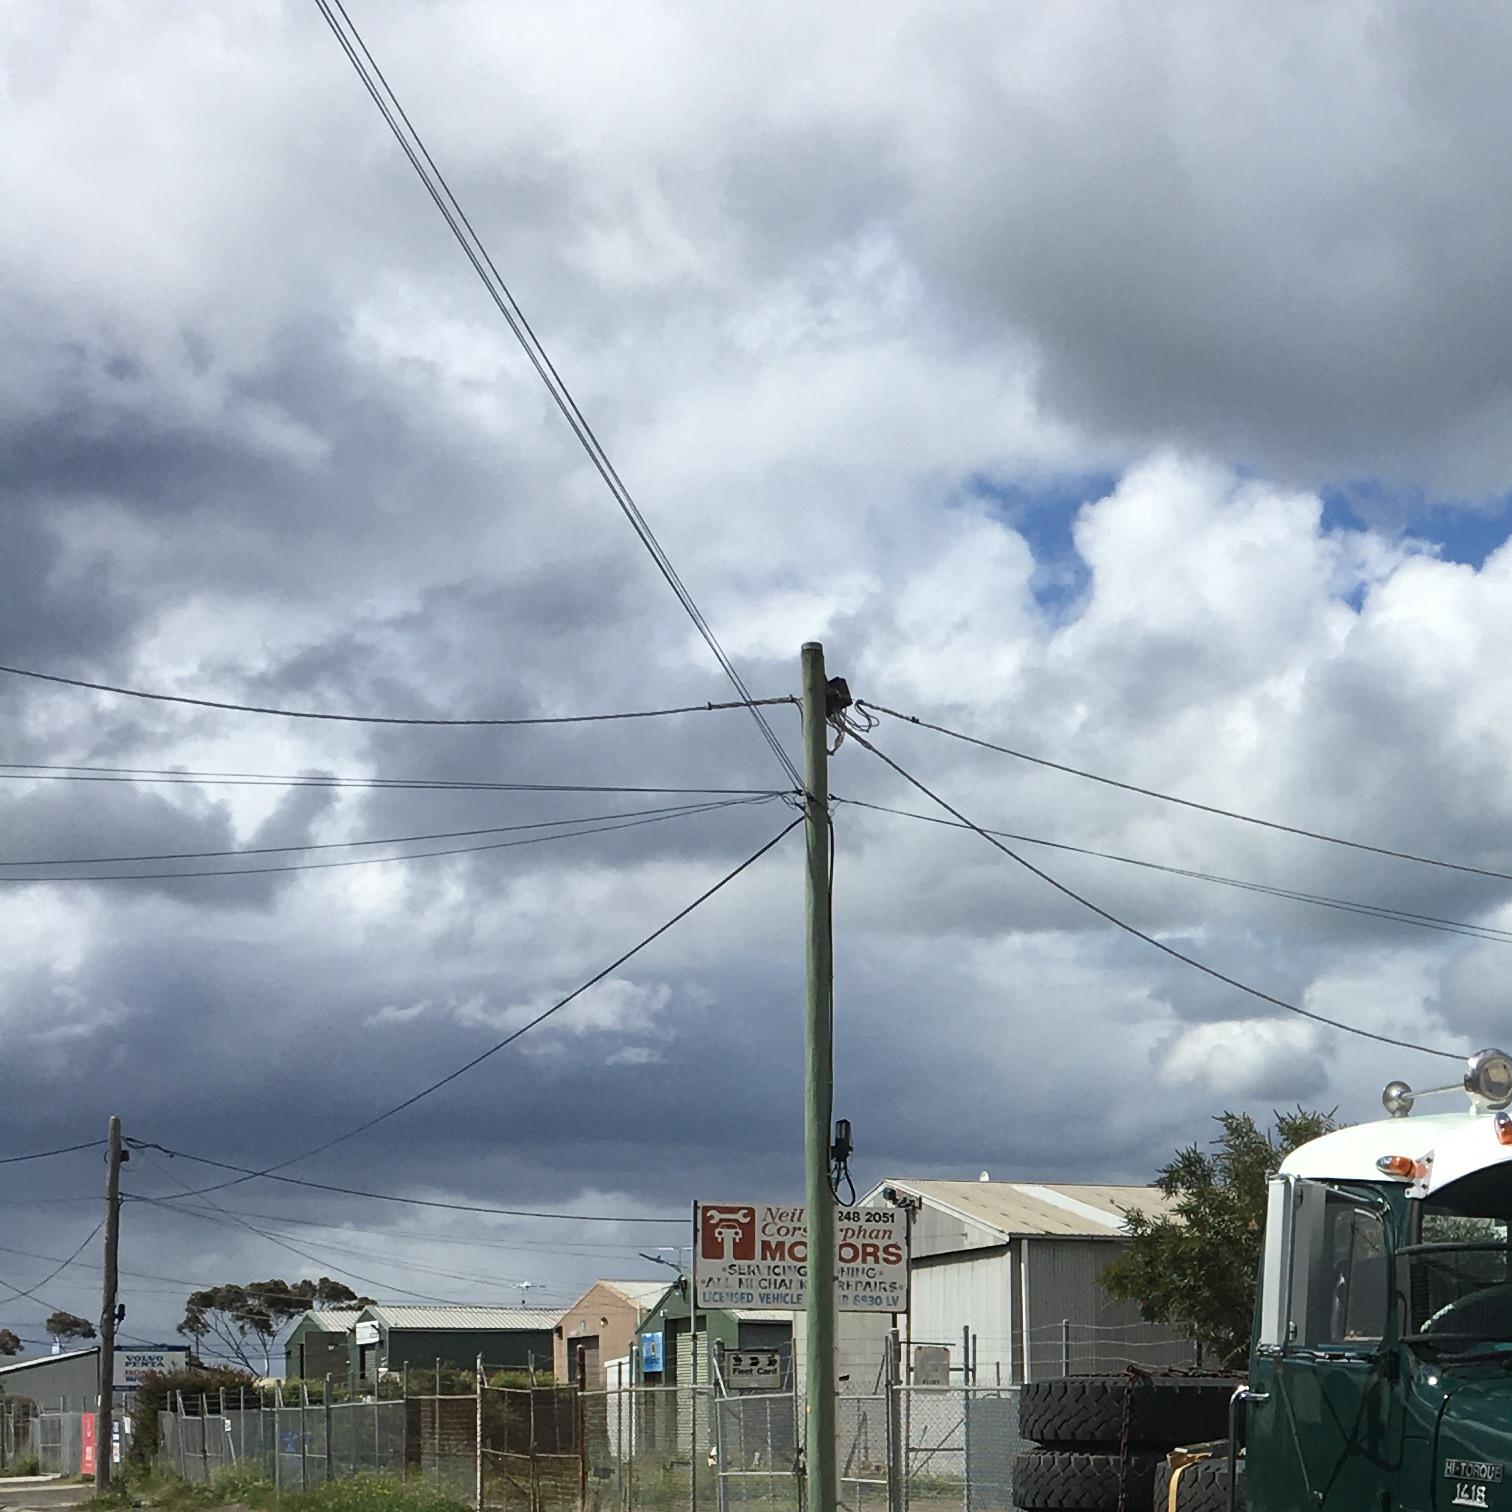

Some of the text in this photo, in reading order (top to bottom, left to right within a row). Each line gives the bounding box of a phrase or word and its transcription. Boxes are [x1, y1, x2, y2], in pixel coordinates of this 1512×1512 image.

[763, 1207, 804, 1222] Neil
[864, 1212, 895, 1223] 2051
[760, 1240, 903, 1265] MOORS
[759, 1293, 803, 1305] VEHICLE
[1444, 1460, 1503, 1481] HI-TORQUE
[1456, 1482, 1487, 1505] 1418
